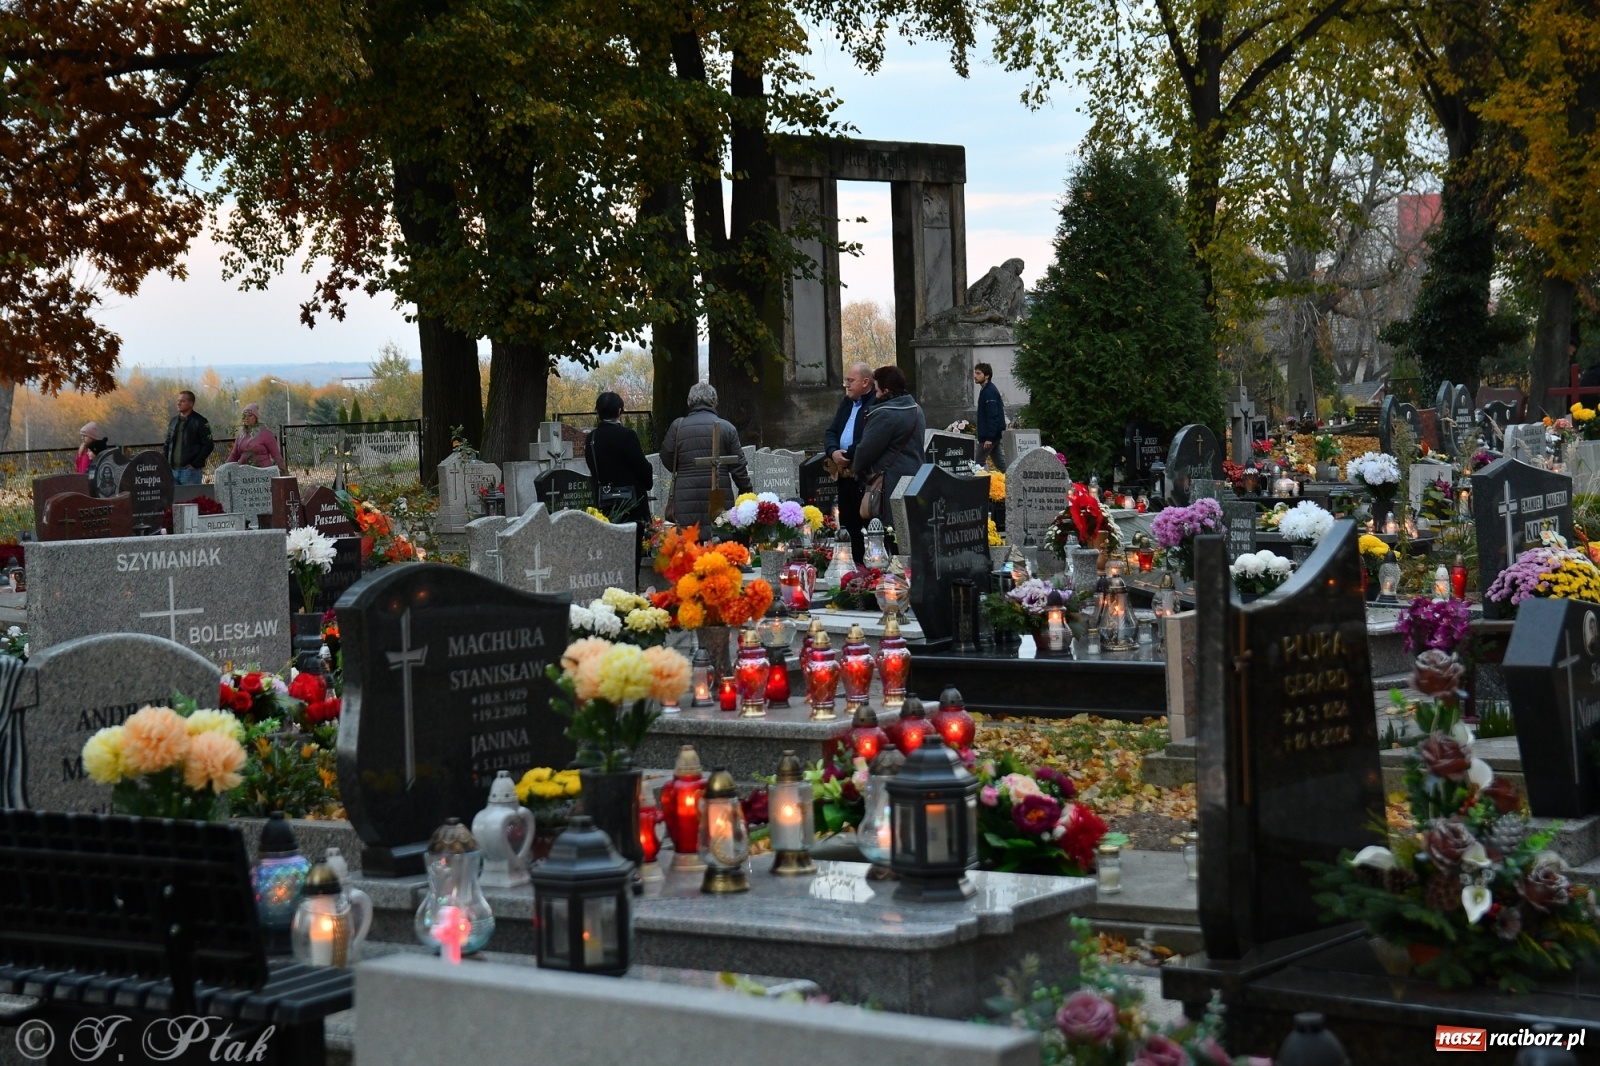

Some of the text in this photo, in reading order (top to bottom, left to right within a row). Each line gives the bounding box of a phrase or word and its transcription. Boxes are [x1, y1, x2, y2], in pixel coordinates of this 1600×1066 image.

[136, 463, 158, 472] Ginter
[134, 475, 161, 487] Kruppa
[946, 506, 982, 526] ZBIGNIEW
[116, 547, 221, 573] SZYMANIAK
[569, 570, 624, 589] BARBARA
[189, 619, 279, 644] BOLESŁAW
[447, 626, 546, 658] MACHURA
[450, 659, 545, 691] STANISŁAW
[471, 727, 530, 758] JANINA
